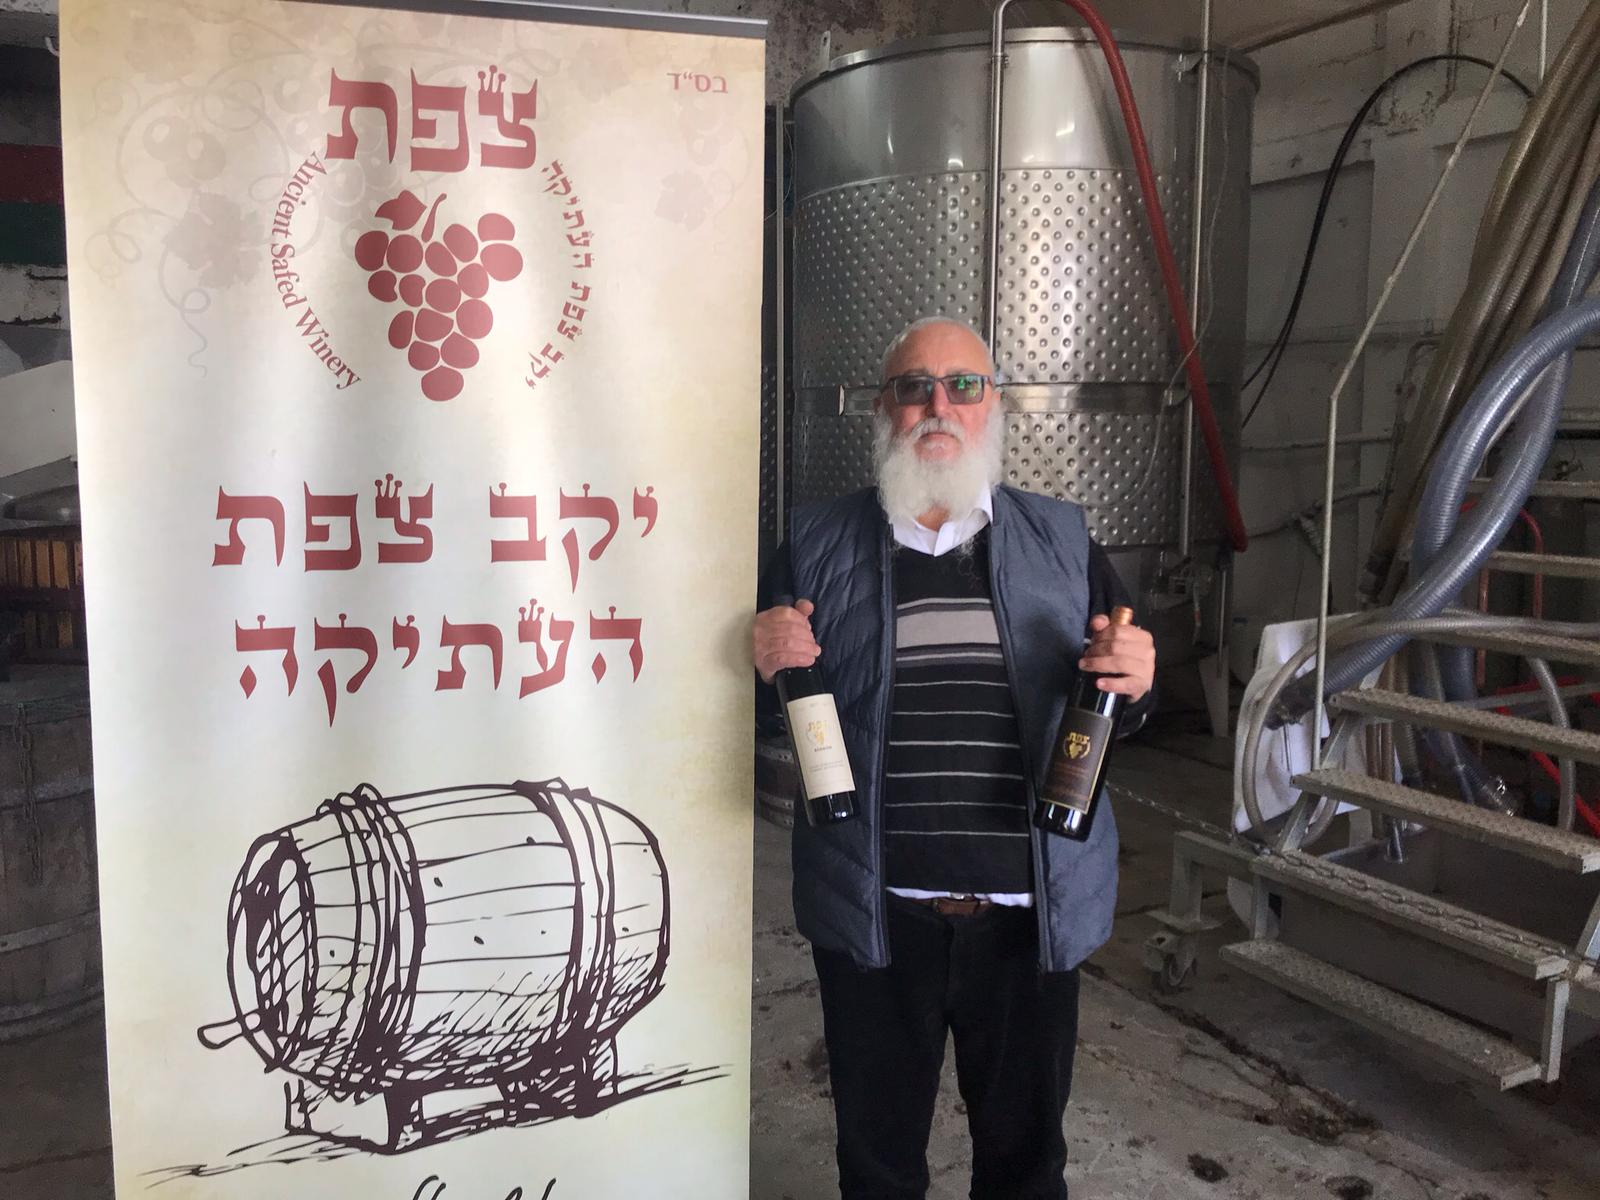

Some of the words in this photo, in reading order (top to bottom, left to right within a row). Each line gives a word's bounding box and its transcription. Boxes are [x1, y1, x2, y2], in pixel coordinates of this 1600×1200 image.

[325, 65, 538, 172] צפת
[271, 150, 328, 238] Ancient
[541, 159, 595, 269] העתיקה
[270, 243, 308, 309] Safed
[556, 281, 592, 342] צפת
[296, 307, 362, 390] Winery
[525, 342, 565, 390] יקב
[212, 473, 433, 572] צפת
[489, 481, 659, 594] יקב
[234, 598, 643, 728] העתיקה
